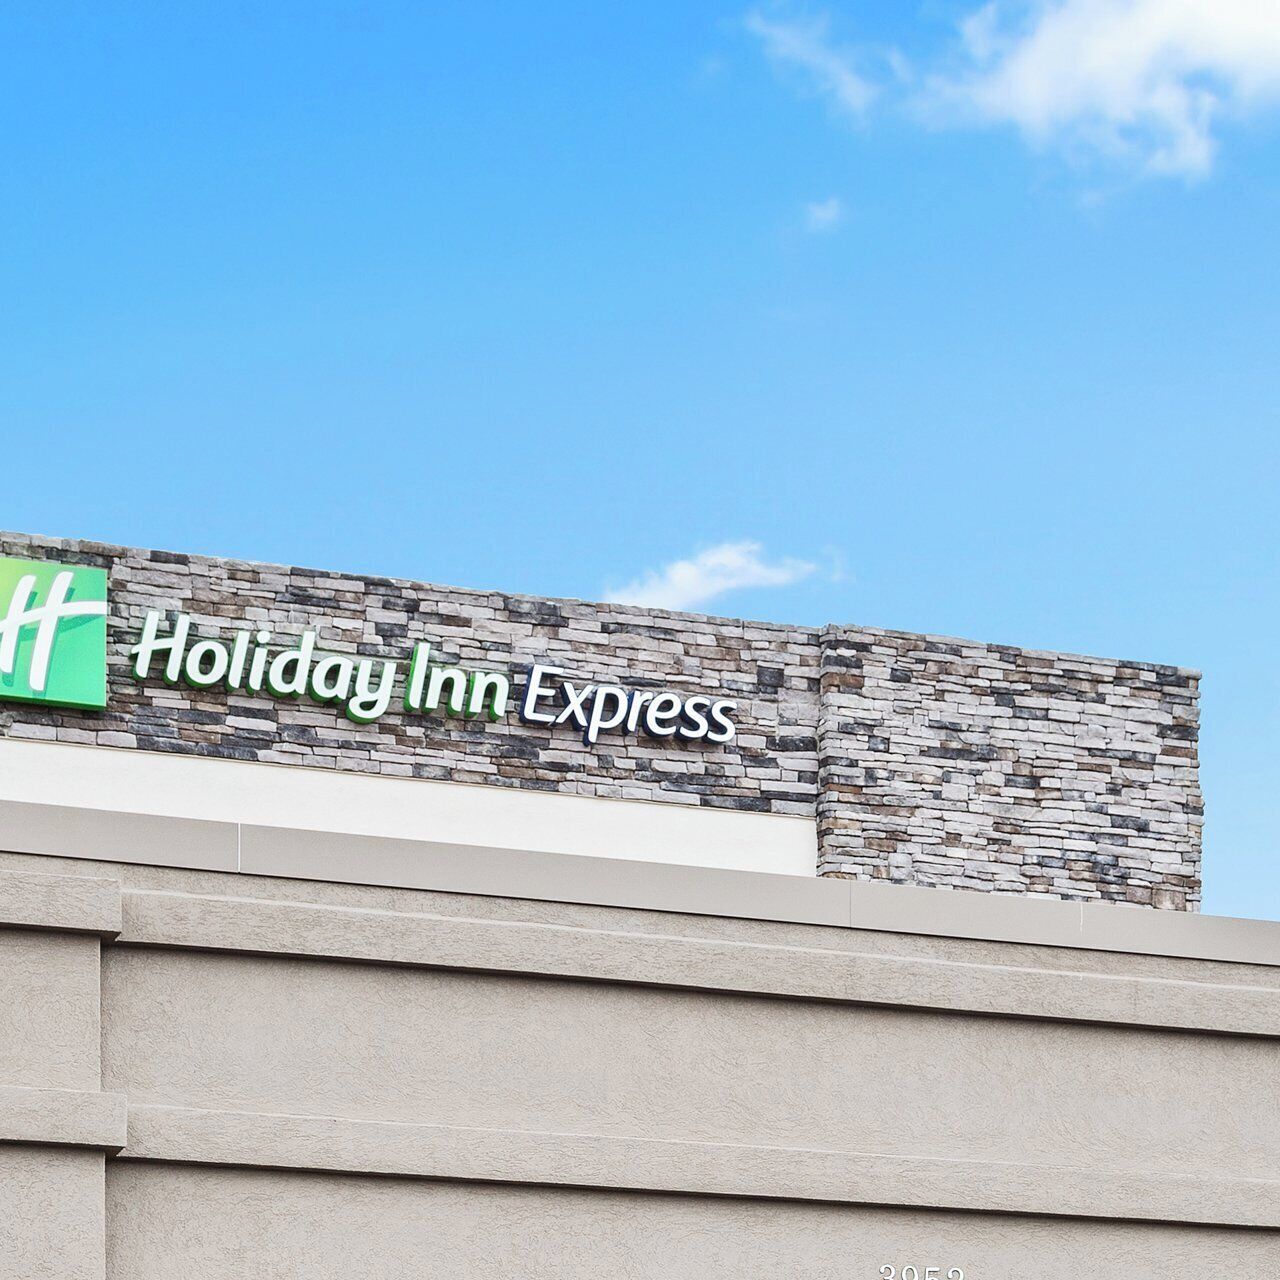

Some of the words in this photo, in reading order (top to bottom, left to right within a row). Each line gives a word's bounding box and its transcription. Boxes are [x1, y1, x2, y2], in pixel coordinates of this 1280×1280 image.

[130, 610, 397, 722] Holiday
[404, 643, 509, 721] Inn
[520, 664, 737, 745] Express
